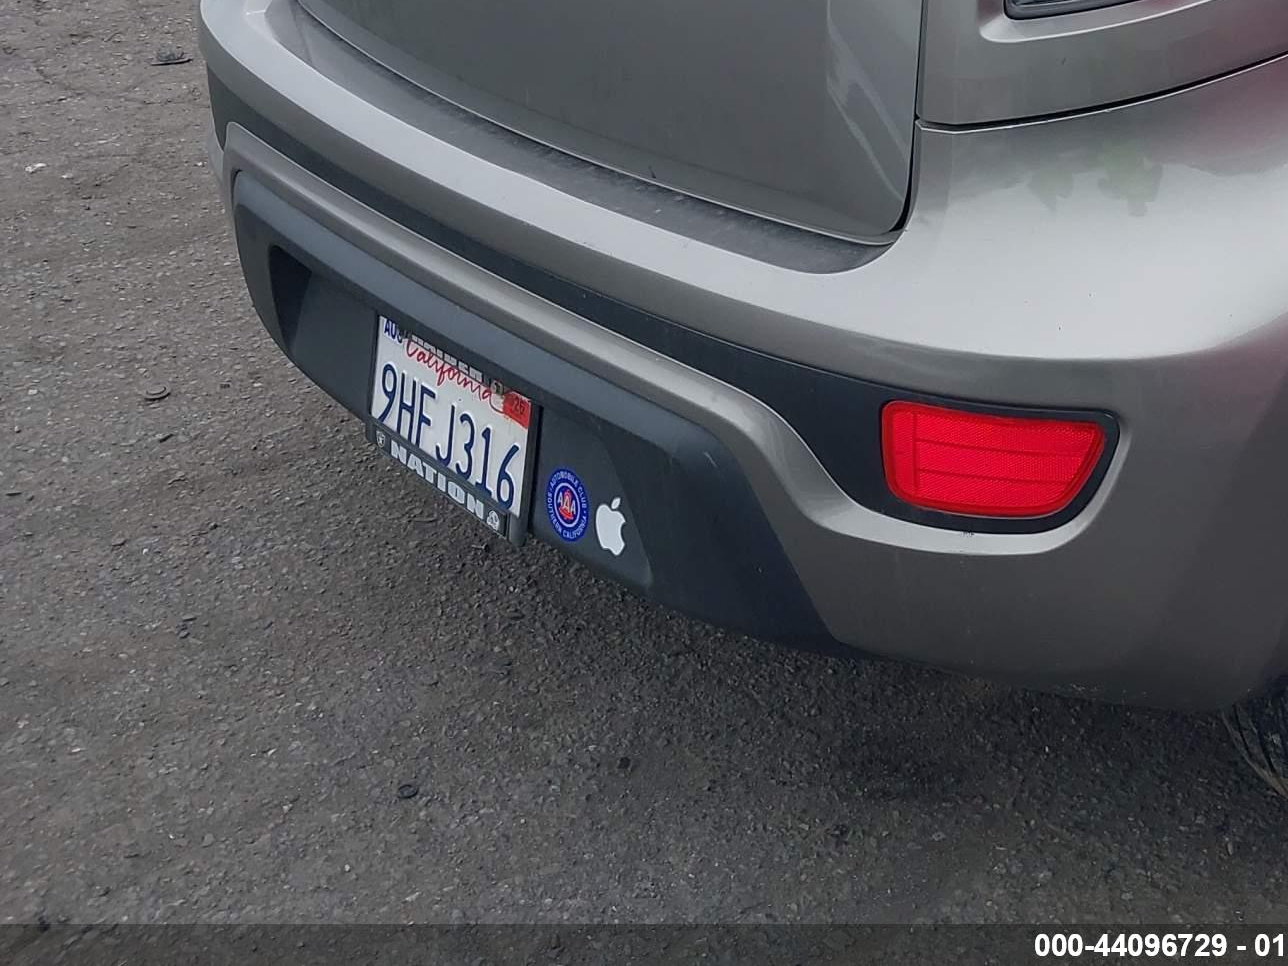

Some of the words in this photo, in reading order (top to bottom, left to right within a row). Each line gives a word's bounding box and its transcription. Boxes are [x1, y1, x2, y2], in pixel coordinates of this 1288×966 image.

[406, 337, 496, 406] California
[376, 361, 520, 511] 9HFJ316
[390, 439, 485, 520] NATION
[557, 491, 577, 516] AAA
[577, 487, 588, 509] CLUB
